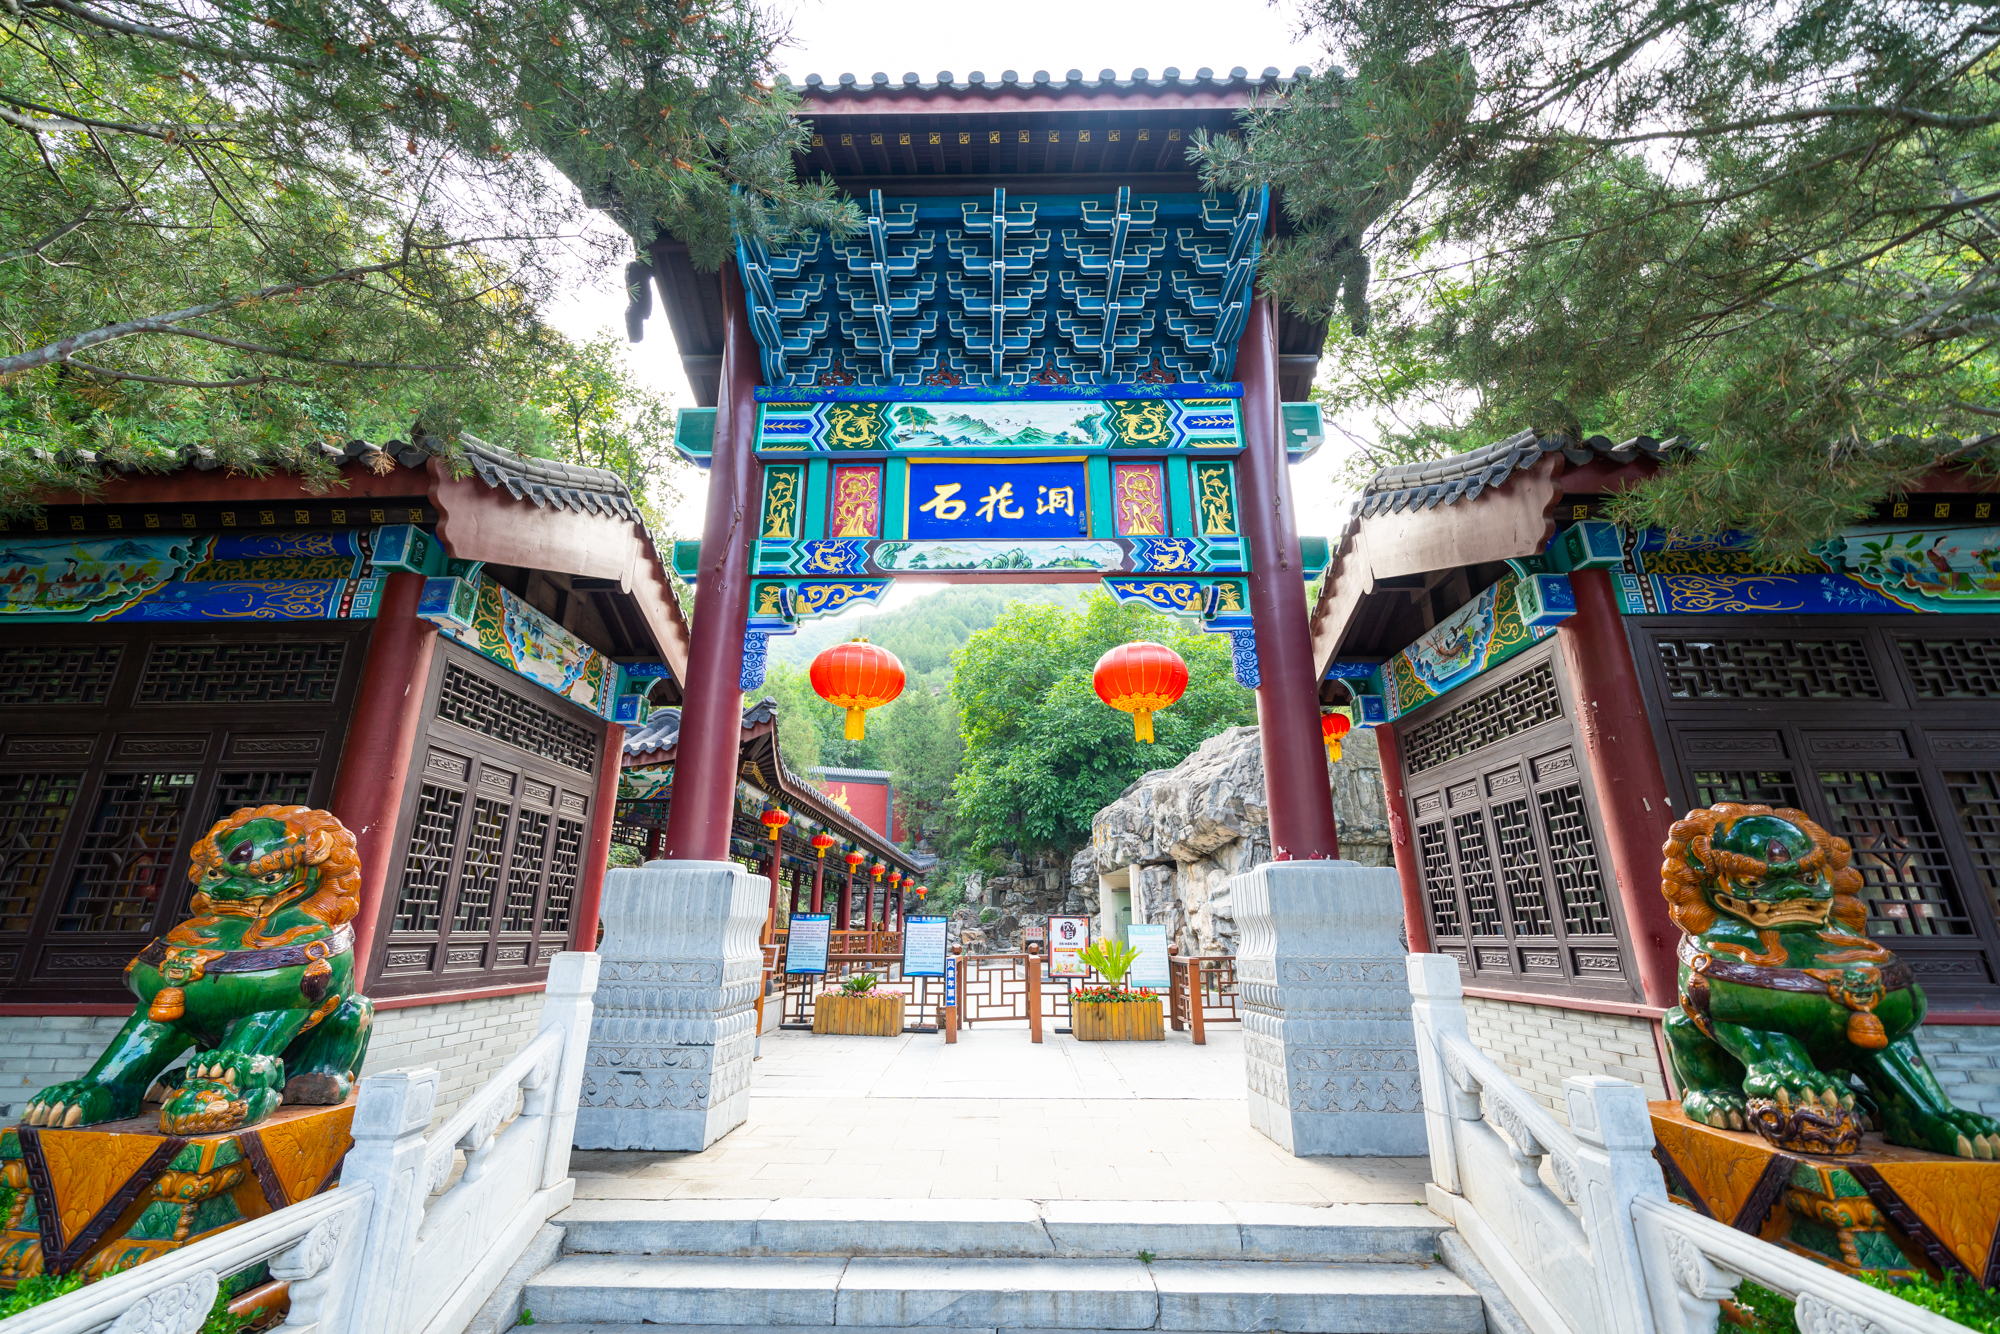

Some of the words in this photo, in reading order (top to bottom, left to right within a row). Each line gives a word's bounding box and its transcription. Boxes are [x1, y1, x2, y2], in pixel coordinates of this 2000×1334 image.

[919, 482, 1075, 522] 石花洞
[947, 960, 955, 998] 风景年票
